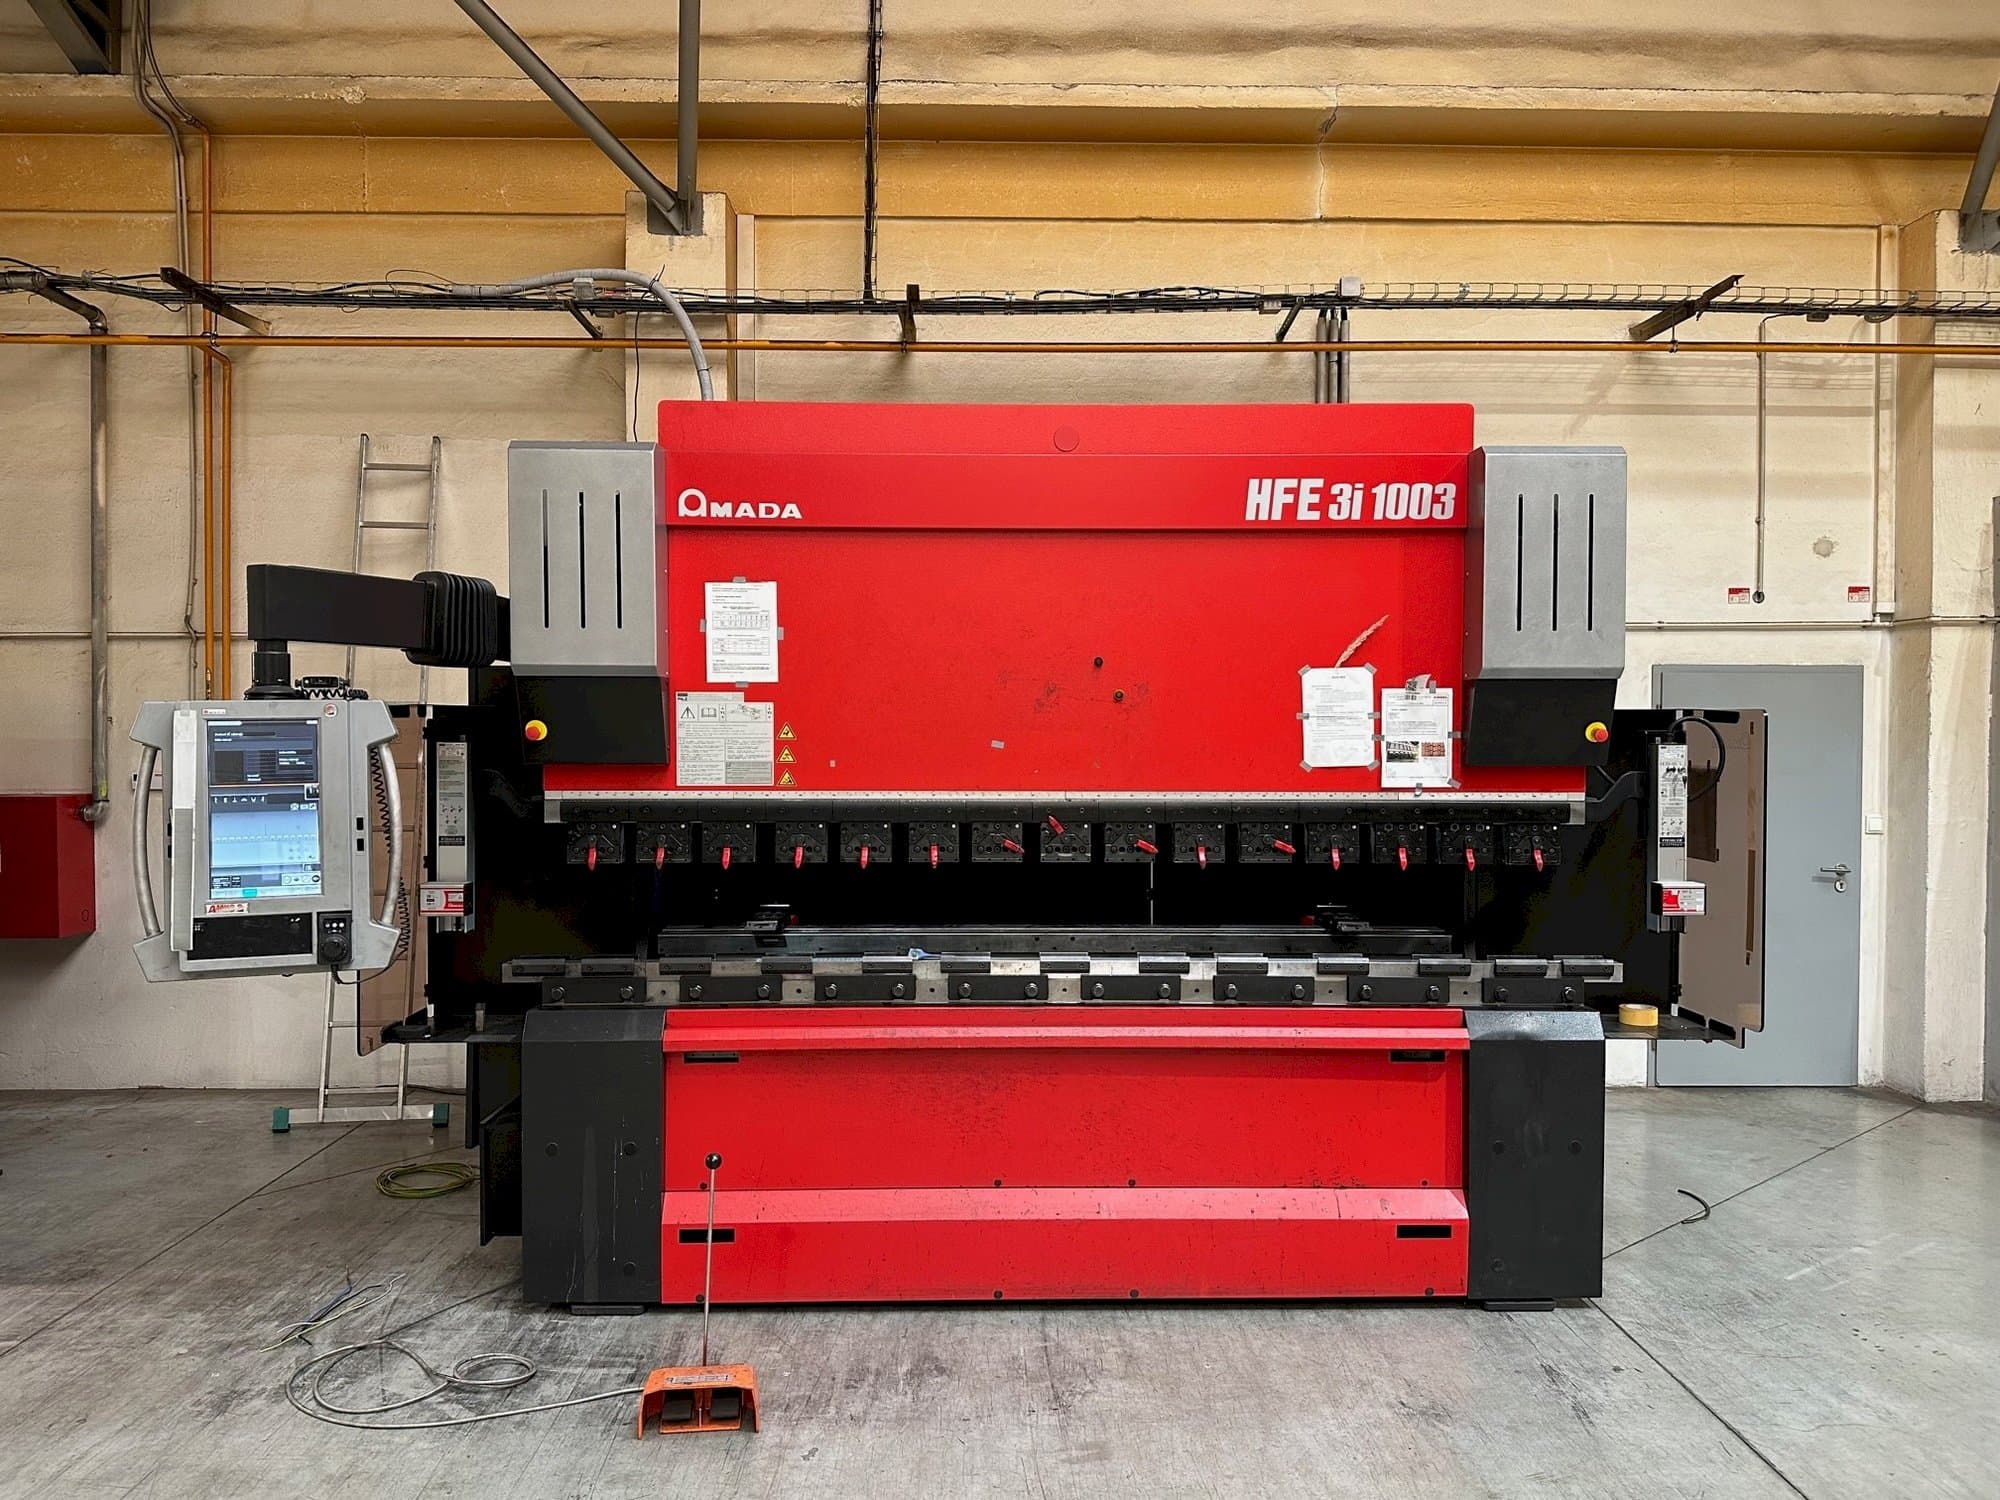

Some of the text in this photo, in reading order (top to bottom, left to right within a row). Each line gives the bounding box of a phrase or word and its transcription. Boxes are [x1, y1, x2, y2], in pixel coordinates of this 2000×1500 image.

[678, 488, 803, 519] AMADA
[1245, 478, 1456, 521] HFE 3i 1003
